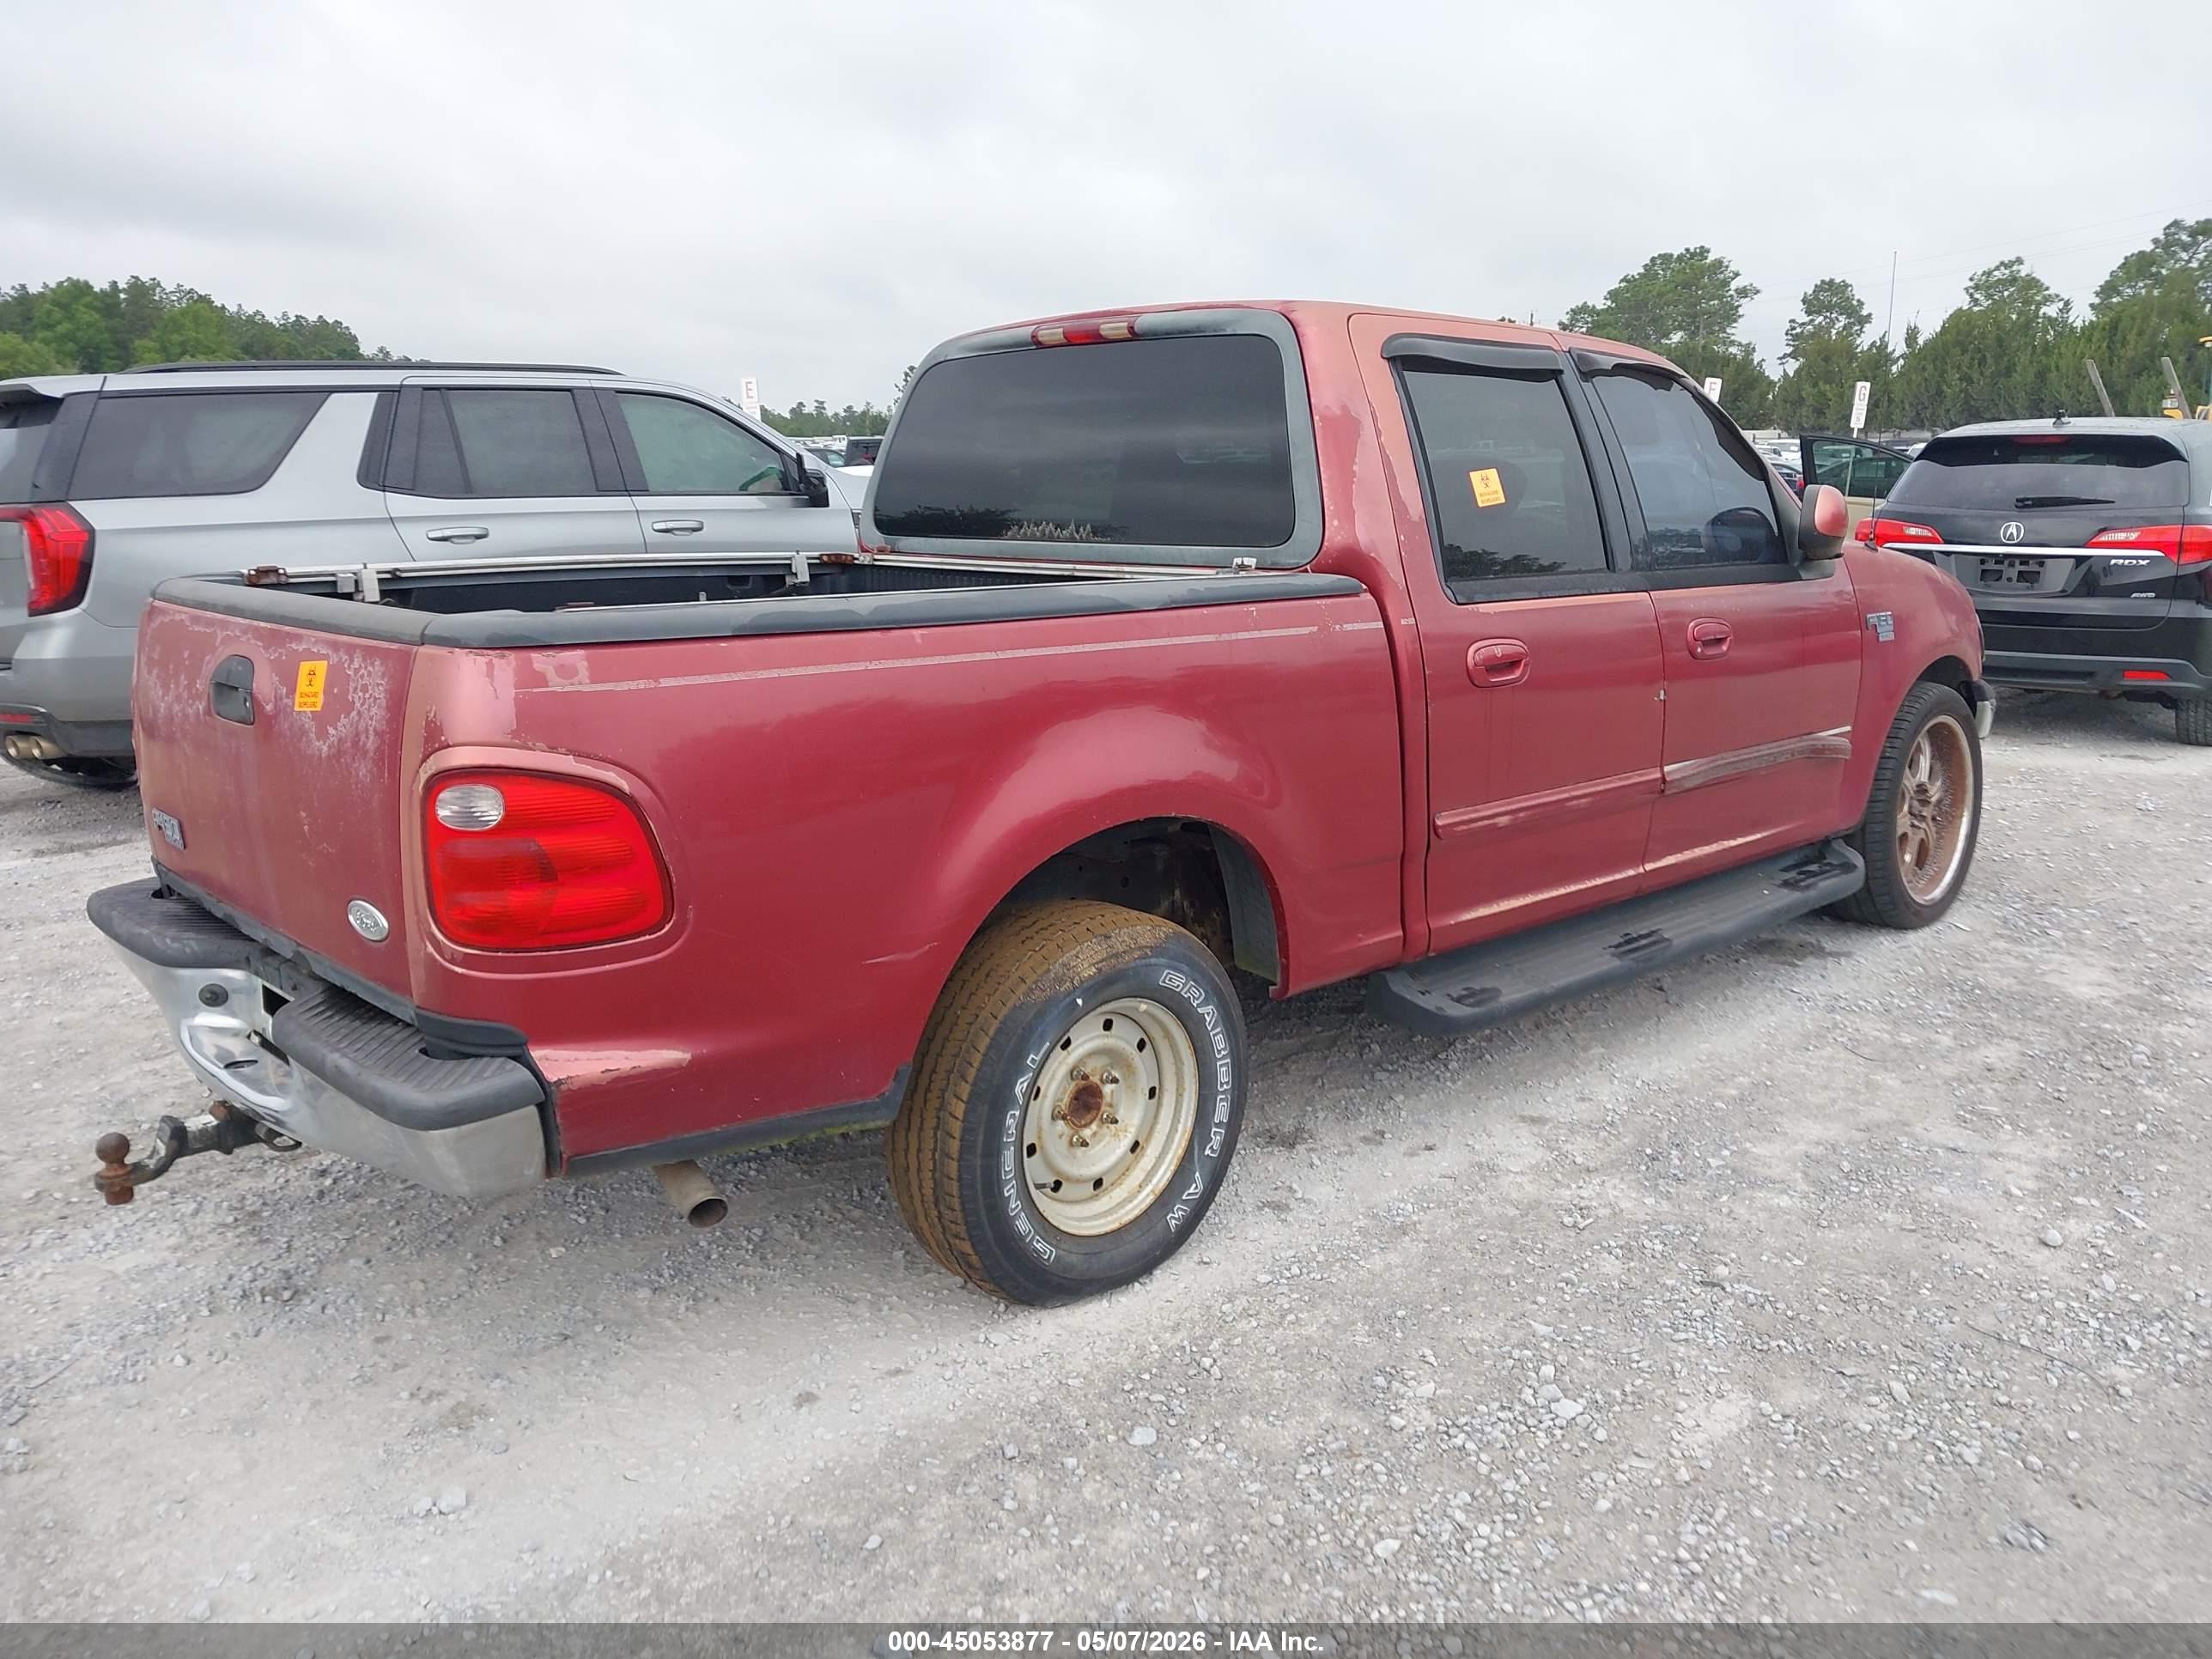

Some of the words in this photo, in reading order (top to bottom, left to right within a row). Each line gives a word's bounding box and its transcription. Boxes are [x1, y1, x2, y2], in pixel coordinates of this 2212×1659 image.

[744, 380, 754, 399] E
[1858, 385, 1868, 402] G
[2109, 558, 2151, 567] RDX
[1158, 969, 1232, 1158] GRABBER
[1001, 1042, 1057, 1266] GENERAL
[1166, 1171, 1204, 1233] AW
